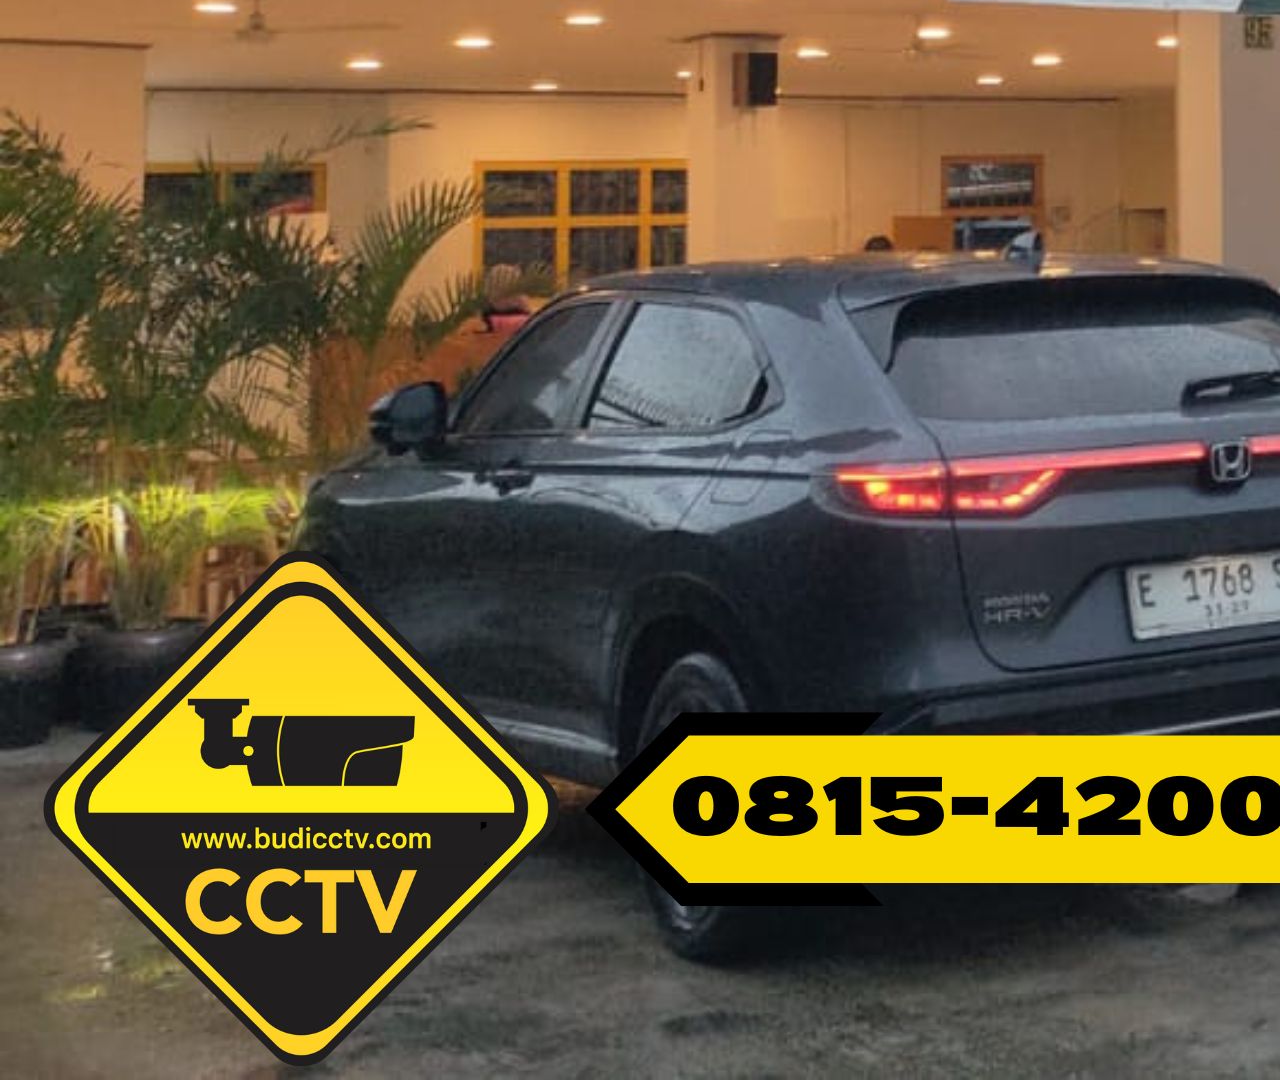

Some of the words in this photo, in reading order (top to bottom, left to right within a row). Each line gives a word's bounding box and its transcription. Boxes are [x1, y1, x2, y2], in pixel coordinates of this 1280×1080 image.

[1243, 16, 1274, 50] 95
[1136, 572, 1157, 608] E
[1181, 563, 1255, 603] 1768
